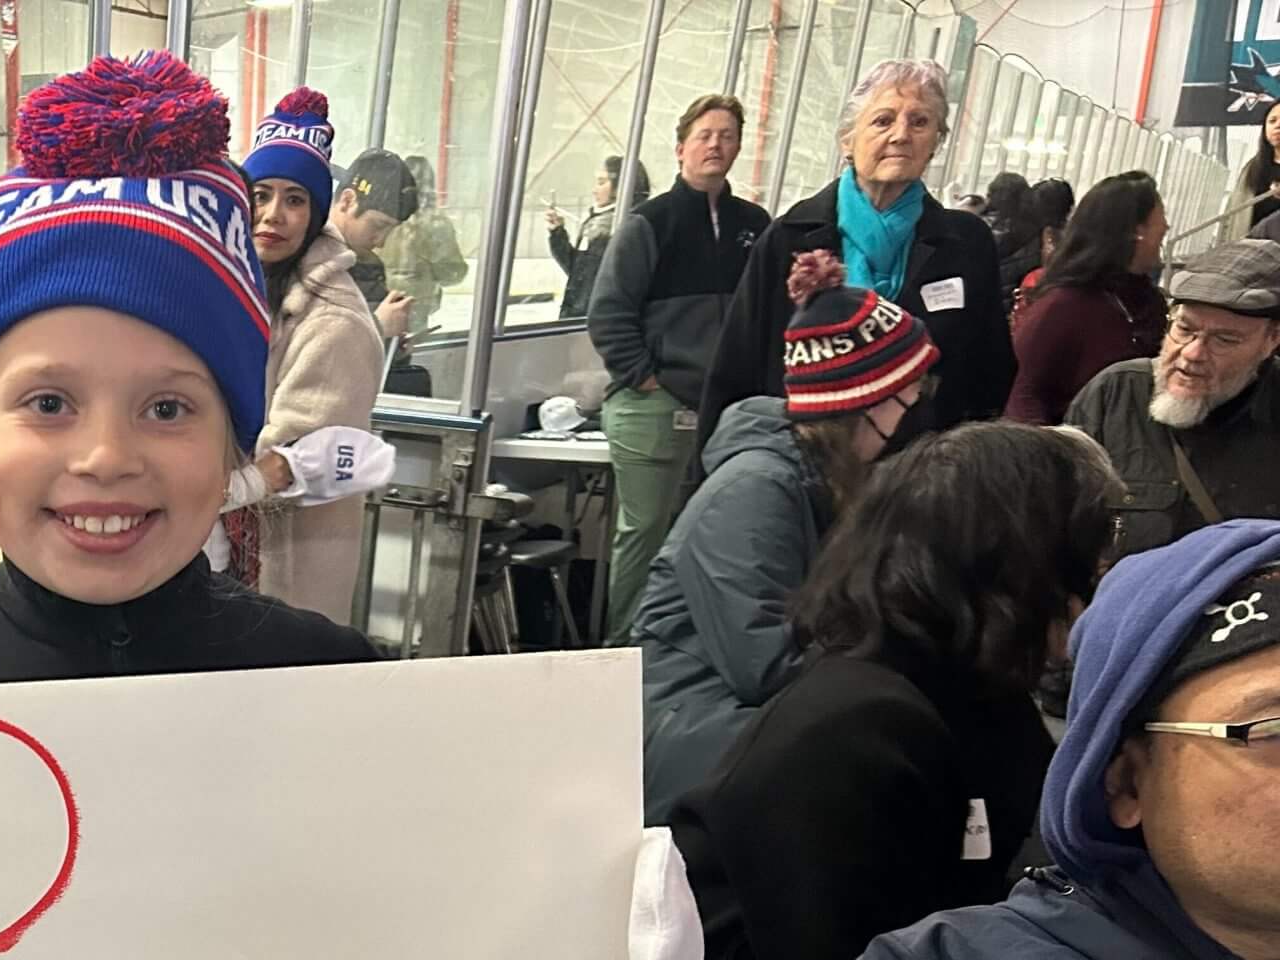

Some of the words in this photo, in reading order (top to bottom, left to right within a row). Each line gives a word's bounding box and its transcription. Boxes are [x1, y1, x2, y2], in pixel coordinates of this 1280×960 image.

[255, 124, 305, 147] TEAM
[146, 178, 256, 283] USA
[335, 445, 355, 481] USA
